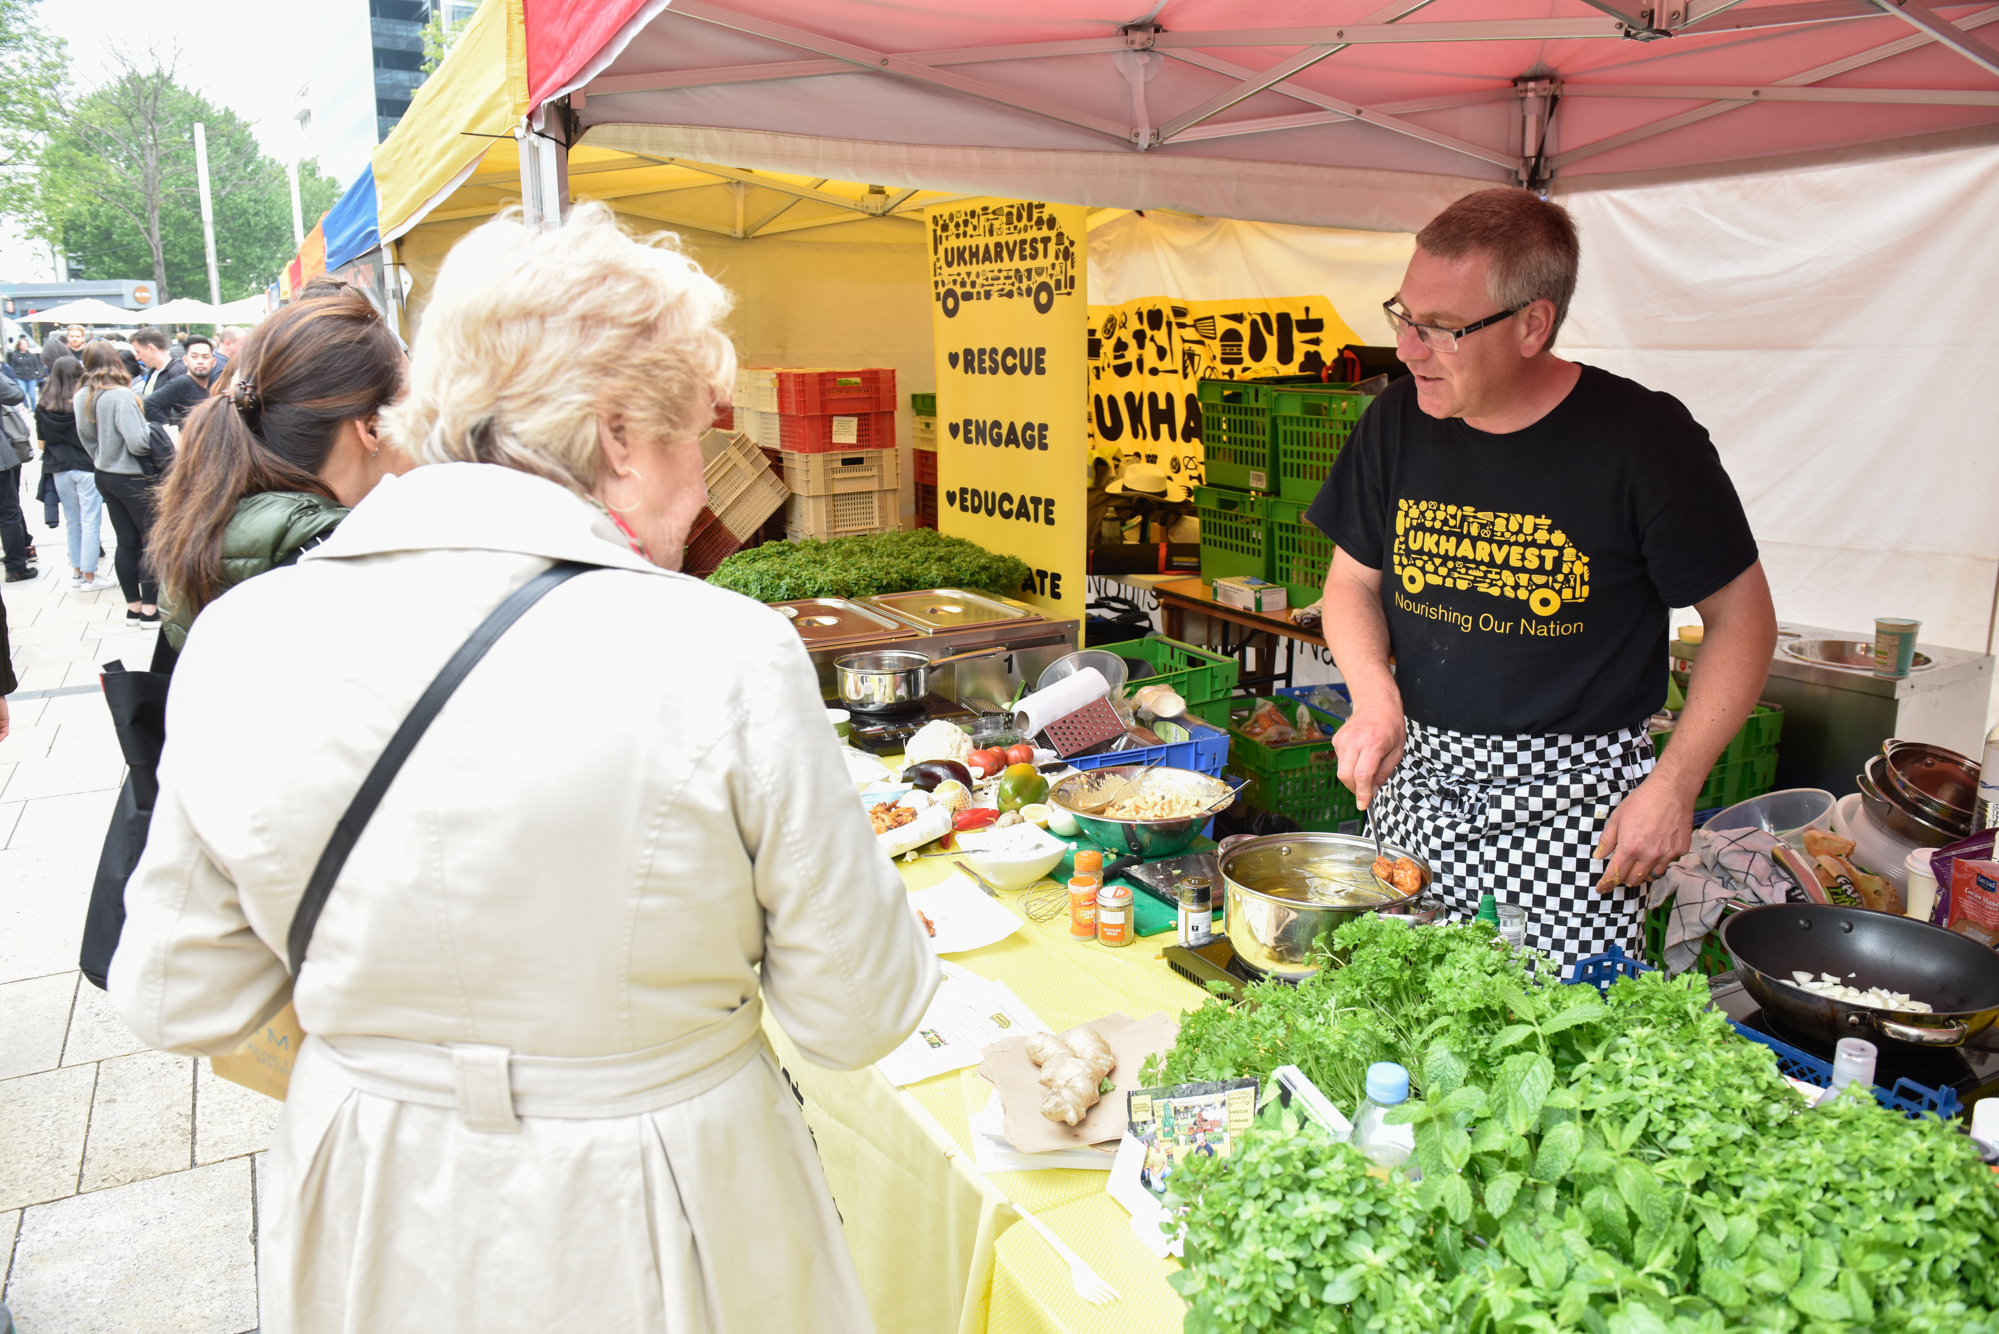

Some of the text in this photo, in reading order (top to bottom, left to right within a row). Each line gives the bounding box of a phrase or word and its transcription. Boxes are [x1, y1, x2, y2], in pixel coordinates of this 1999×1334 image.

[944, 237, 1050, 268] UKHARVEST
[963, 346, 1047, 376] RESCUE
[962, 418, 1049, 451] ENGAGE
[1094, 391, 1204, 446] UKHA
[958, 487, 1056, 526] EDUCATE
[1408, 529, 1559, 570] UKHARVEST
[1021, 567, 1062, 600] ATE
[1395, 591, 1584, 637] Nourishing Our Nation
[1003, 654, 1013, 674] 1
